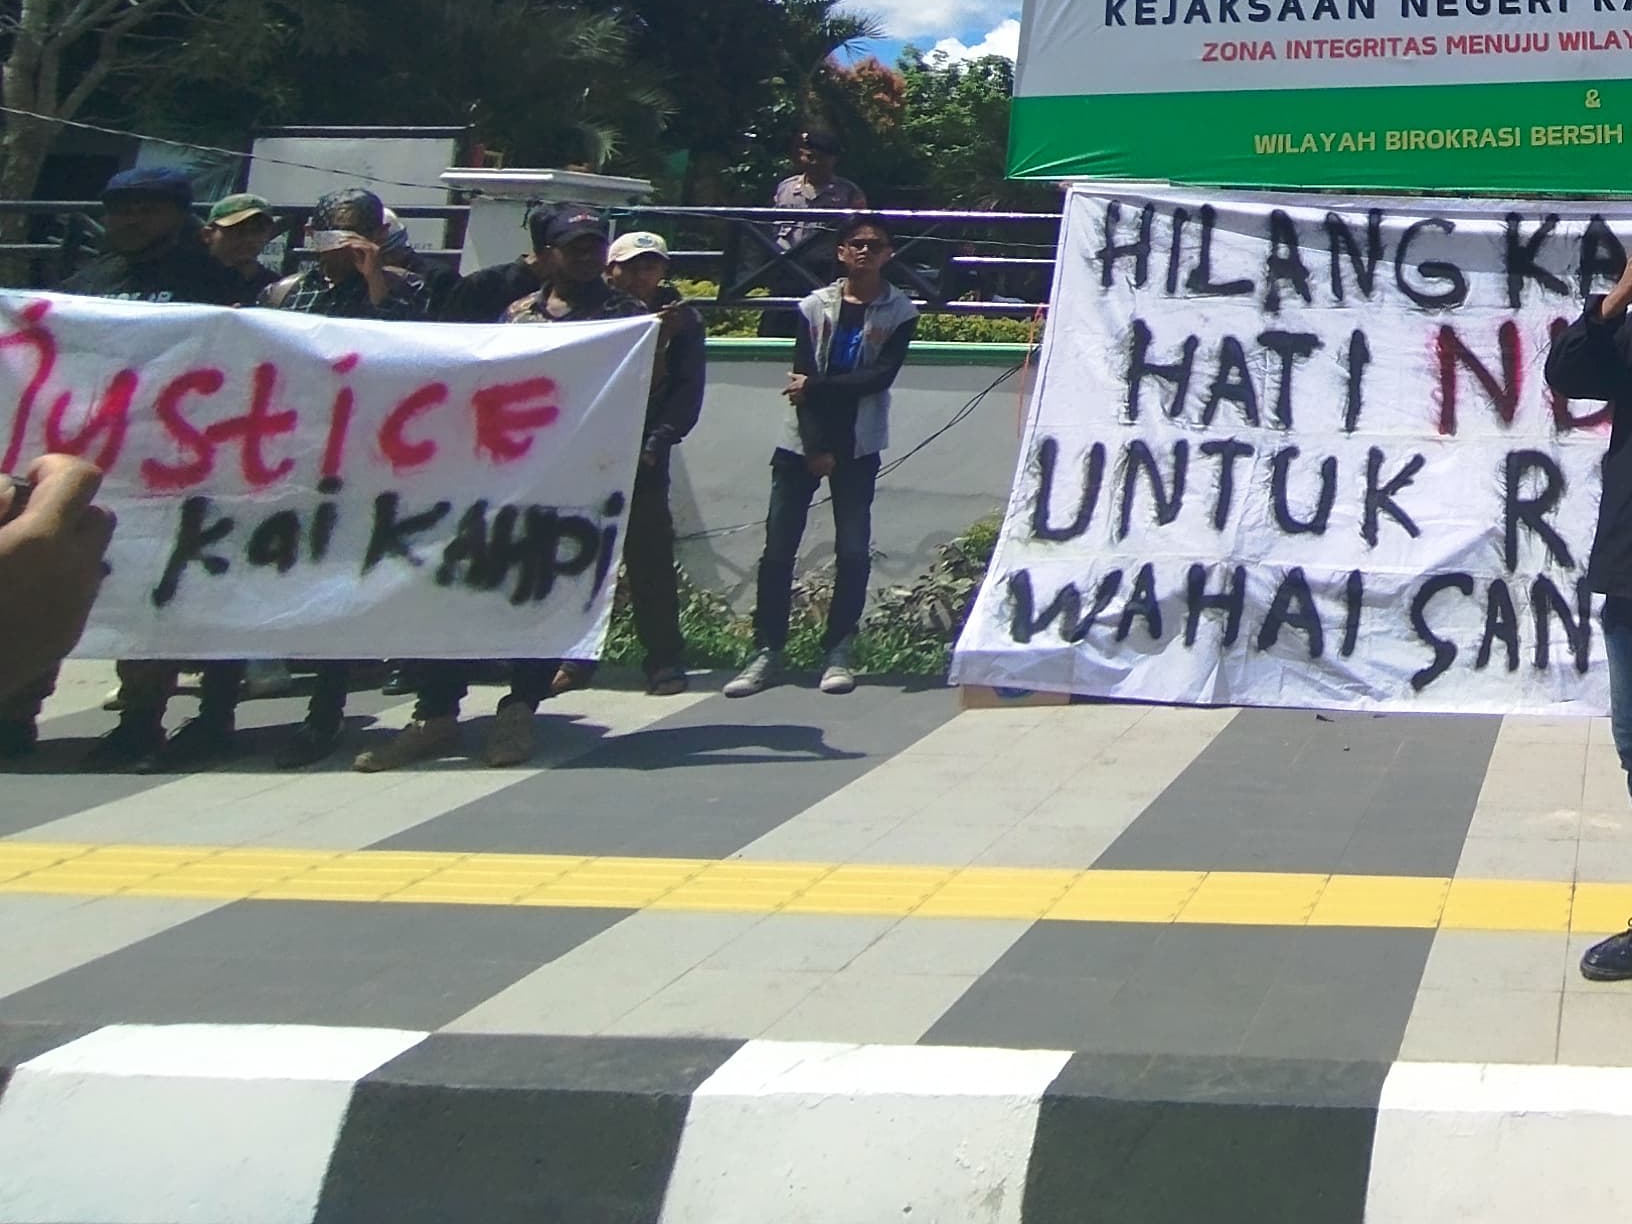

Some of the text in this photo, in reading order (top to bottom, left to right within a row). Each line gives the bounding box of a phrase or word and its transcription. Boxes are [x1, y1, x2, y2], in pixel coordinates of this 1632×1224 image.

[1201, 40, 1278, 63] ZONA
[1285, 36, 1438, 60] INTEGRITAS
[1445, 32, 1550, 56] MENUJU
[1585, 88, 1601, 109] &
[1253, 131, 1376, 155] WILAYAH
[1385, 126, 1522, 152] BIROKRASI
[1530, 122, 1624, 147] BERSIH
[1100, 200, 1627, 313] HILANG KA
[1125, 318, 1370, 433] HATI
[1031, 434, 1426, 548] UNTUK
[1007, 561, 1365, 659] WAHAI
[1409, 572, 1593, 693] SAN
